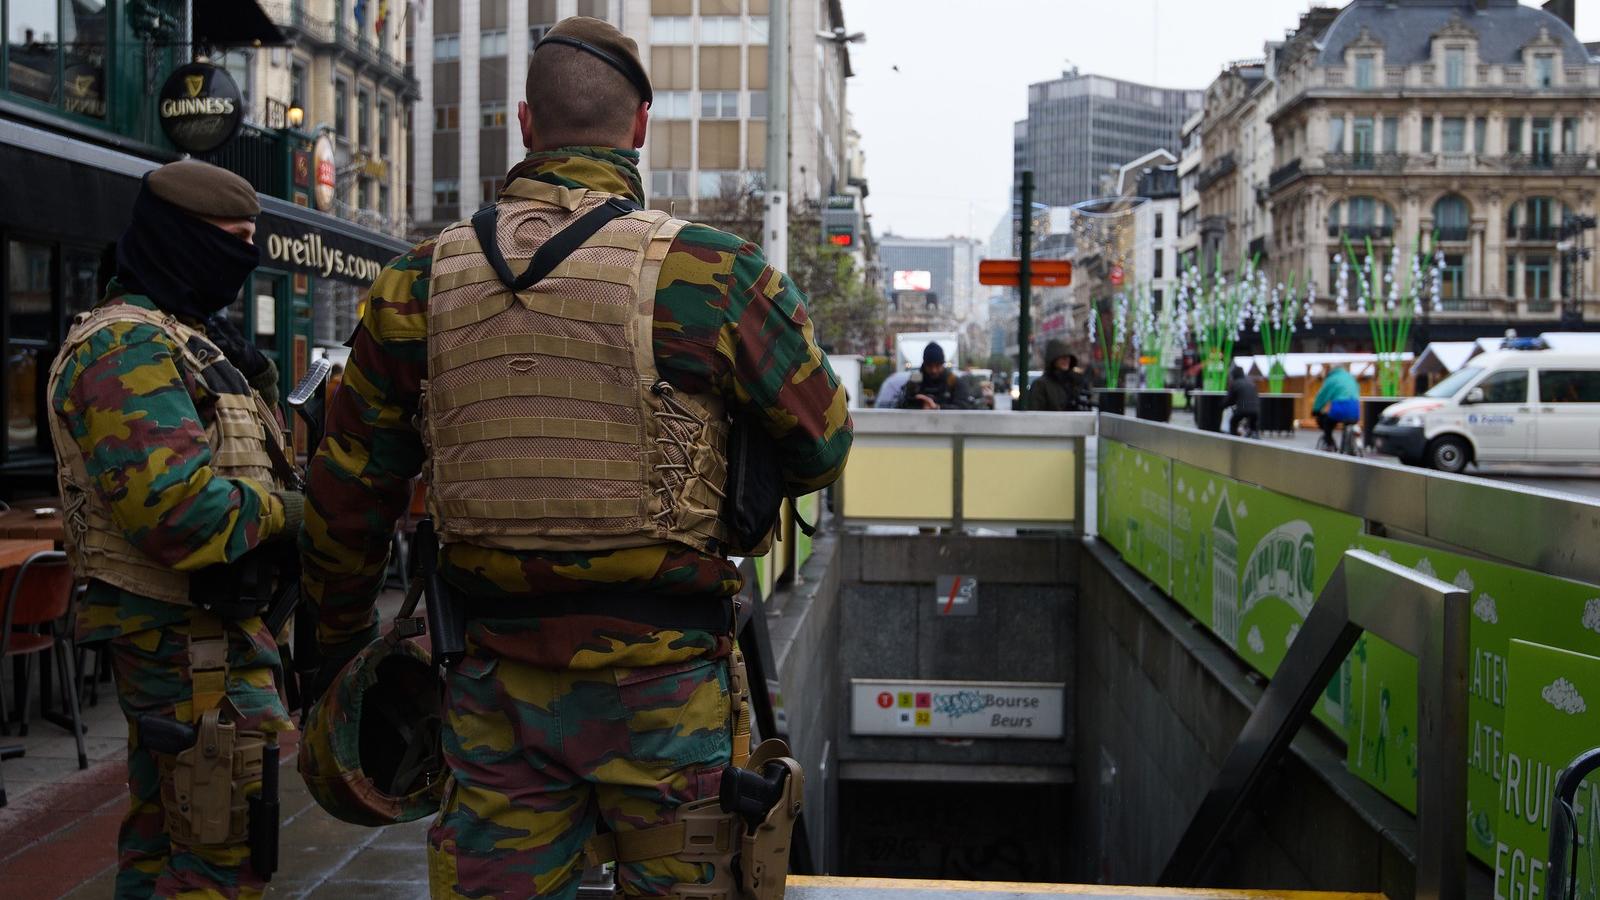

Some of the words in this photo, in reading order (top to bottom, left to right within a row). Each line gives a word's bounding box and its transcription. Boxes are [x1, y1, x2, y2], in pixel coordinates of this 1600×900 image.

[161, 97, 235, 118] GUINNESS
[267, 232, 382, 281] oreillys.com
[1468, 647, 1508, 708] ATEN
[986, 694, 1040, 708] Bourse
[991, 713, 1033, 728] Beurs
